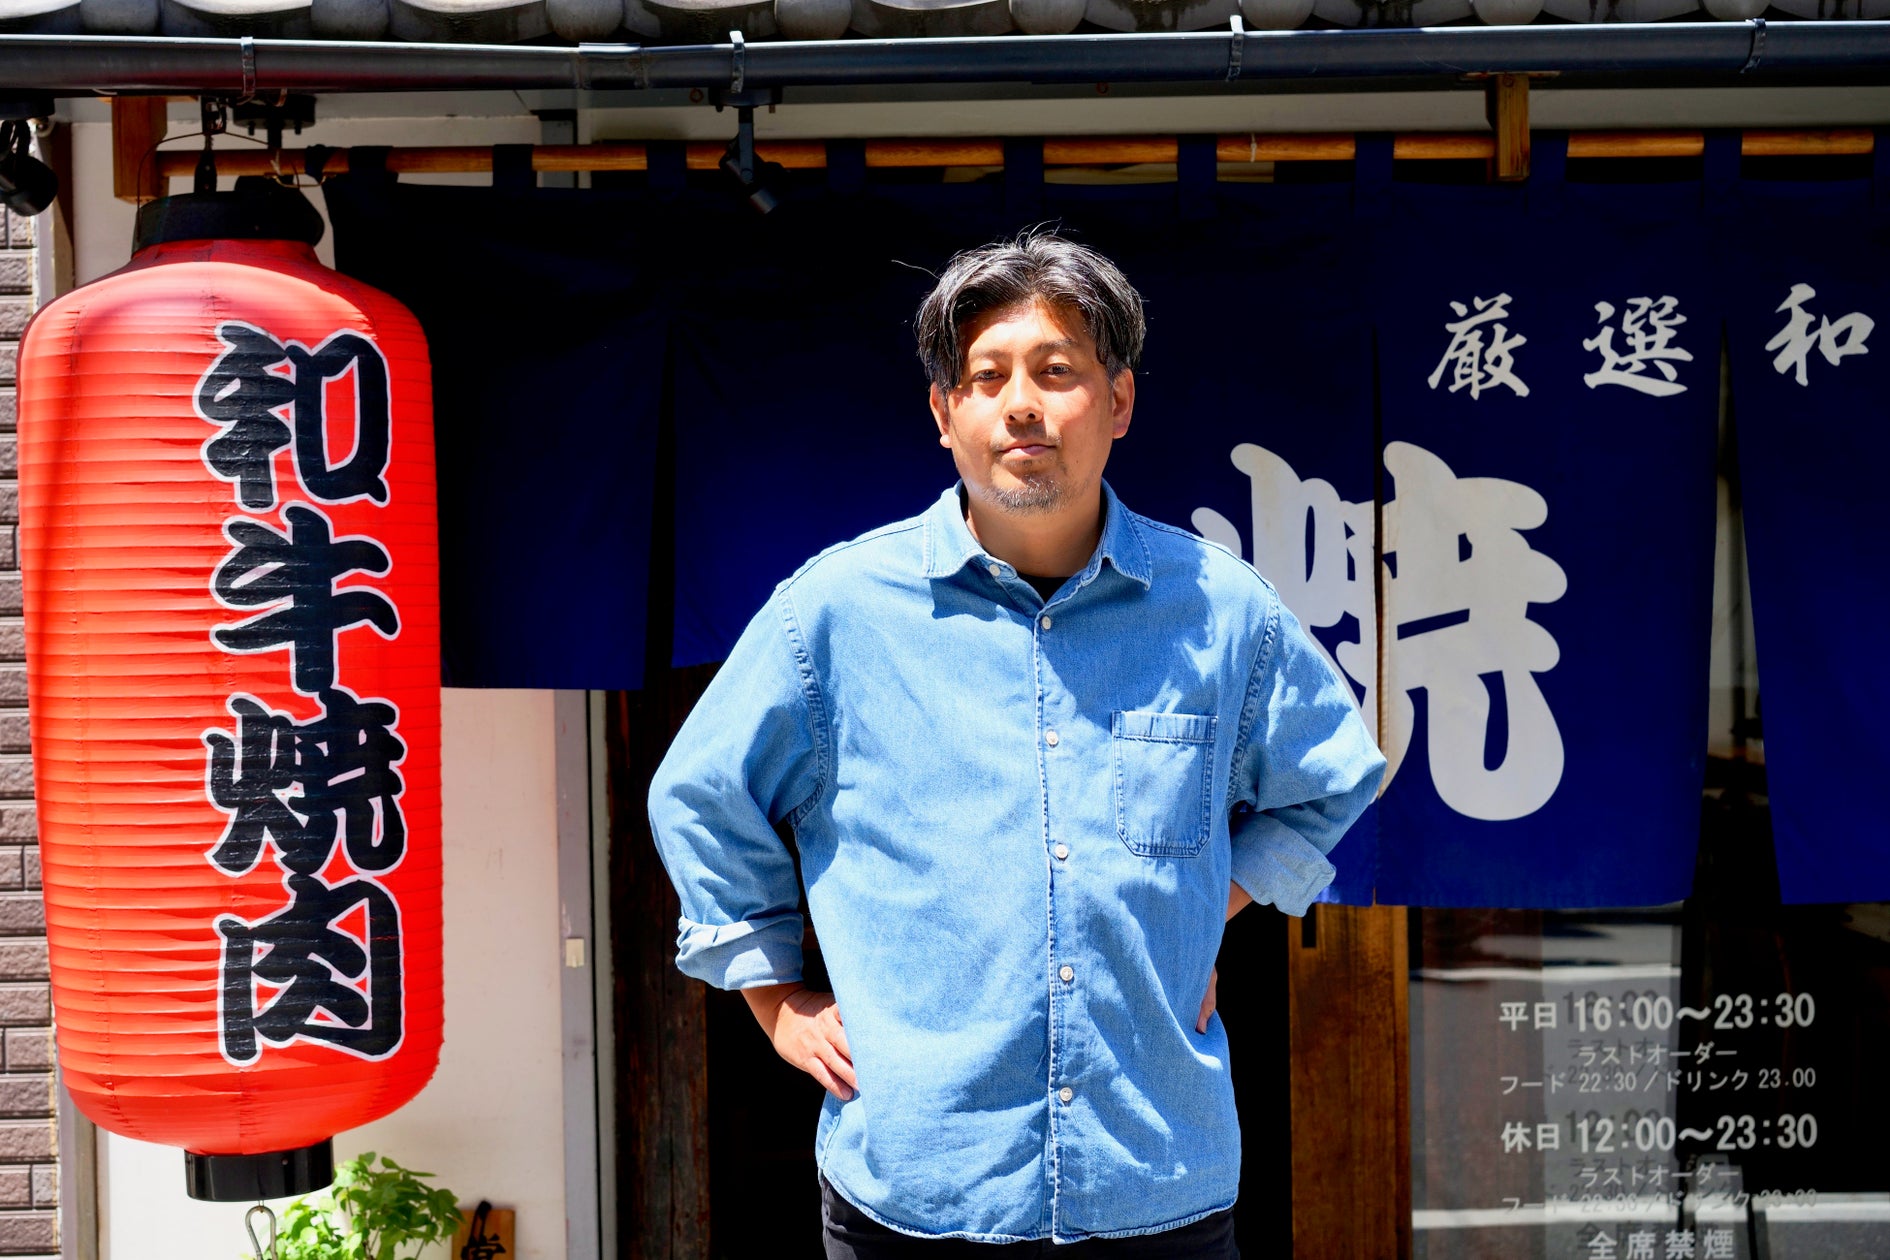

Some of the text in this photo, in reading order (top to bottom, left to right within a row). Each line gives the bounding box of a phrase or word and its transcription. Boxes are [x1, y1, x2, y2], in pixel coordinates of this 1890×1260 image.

[1190, 440, 1568, 821] 焼
[193, 320, 408, 1066] 和牛焼肉
[1499, 1001, 1558, 1031] 平日
[1578, 1040, 1738, 1067] ラストオーダー
[1500, 1121, 1560, 1153] 休日
[1580, 1162, 1740, 1188] ラストオーダー
[1587, 1229, 1736, 1260] 全席禁煙
